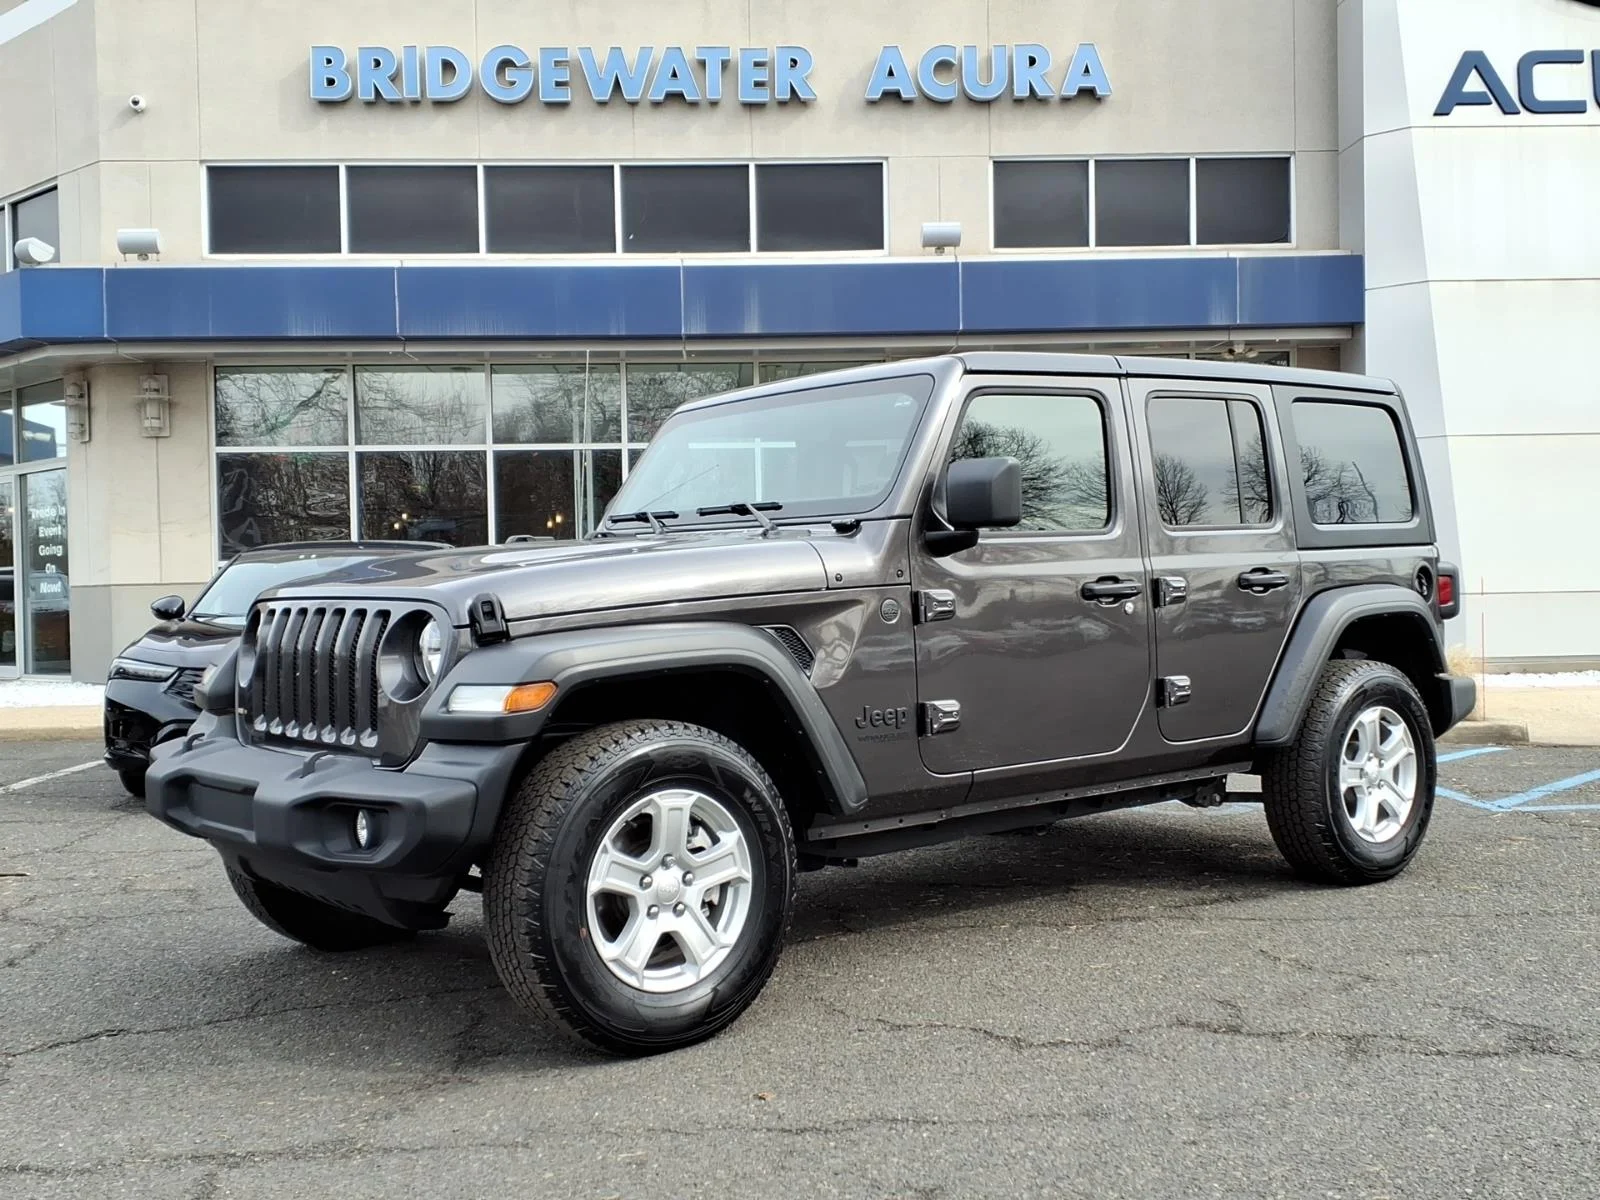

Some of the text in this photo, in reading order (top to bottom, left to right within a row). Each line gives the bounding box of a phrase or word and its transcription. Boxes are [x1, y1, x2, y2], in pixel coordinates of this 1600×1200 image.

[310, 42, 1113, 105] BRIDGEWATER ACURA
[1433, 48, 1600, 116] AC
[38, 525, 61, 538] Event
[38, 545, 63, 556] Going
[45, 563, 56, 573] On
[39, 581, 61, 593] Now!
[855, 705, 908, 729] Jeep
